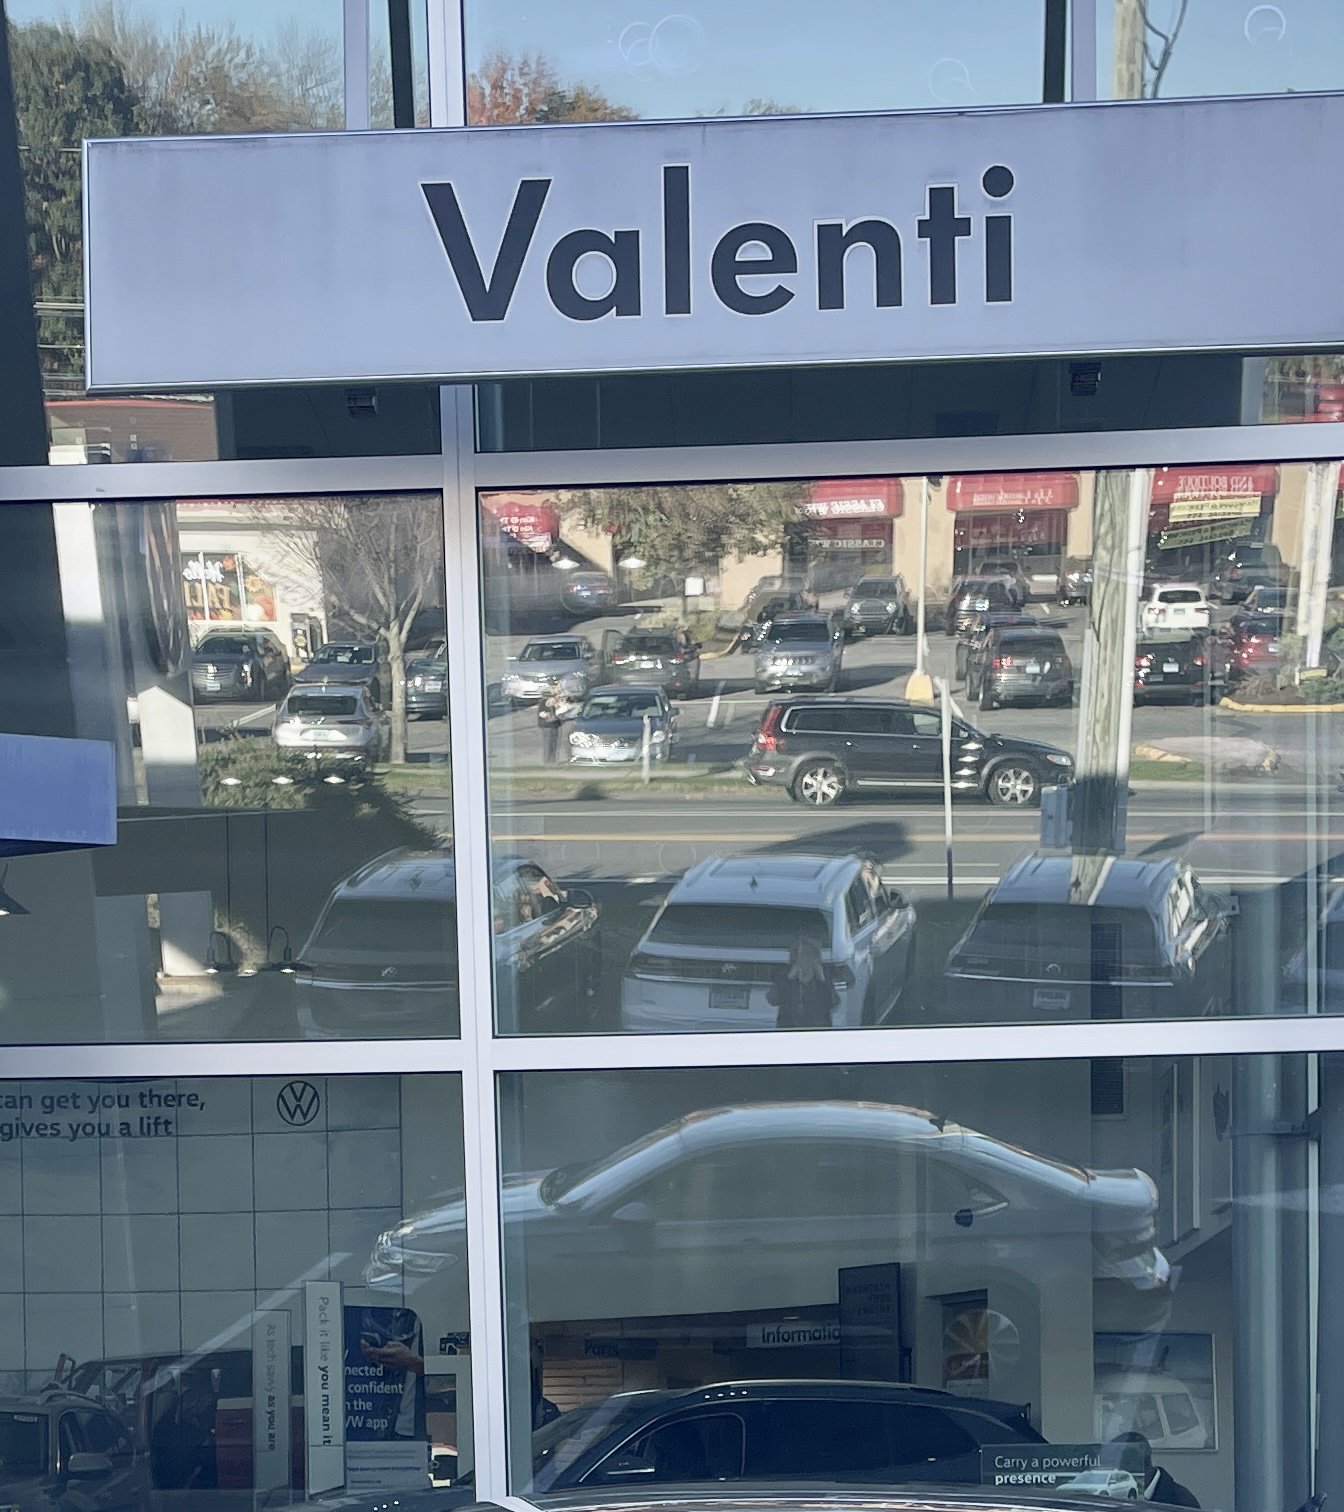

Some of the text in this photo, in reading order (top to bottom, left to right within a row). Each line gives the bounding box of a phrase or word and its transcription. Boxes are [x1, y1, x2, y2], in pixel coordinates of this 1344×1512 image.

[419, 163, 1017, 323] Valenti
[42, 1091, 81, 1114] get
[89, 1093, 130, 1114] you
[139, 1088, 206, 1111] there,
[0, 1118, 61, 1142] gives
[68, 1120, 111, 1142] you
[119, 1121, 132, 1136] a
[139, 1117, 173, 1136] lift
[320, 1341, 331, 1362] like
[318, 1365, 330, 1390] you
[348, 1382, 404, 1394] confident
[267, 1394, 276, 1409] as
[353, 1399, 373, 1411] the
[265, 1409, 276, 1434] you
[322, 1393, 331, 1432] mean
[366, 1418, 388, 1431] app
[323, 1434, 332, 1446] it
[995, 1454, 1101, 1470] Carry a powerful
[995, 1474, 1056, 1486] presence
